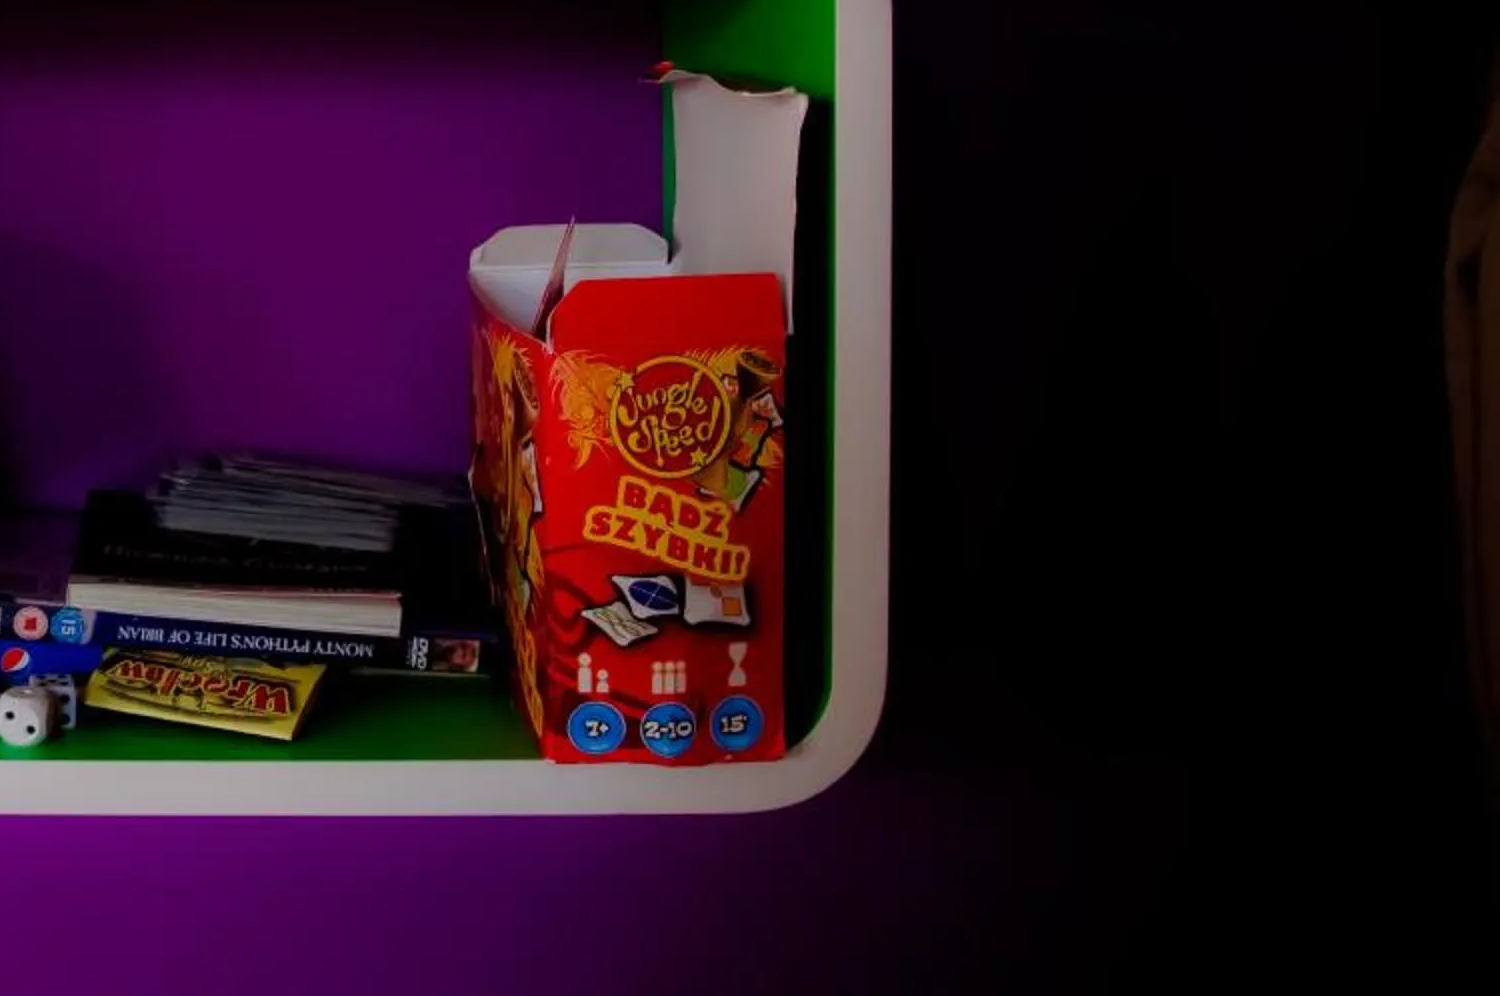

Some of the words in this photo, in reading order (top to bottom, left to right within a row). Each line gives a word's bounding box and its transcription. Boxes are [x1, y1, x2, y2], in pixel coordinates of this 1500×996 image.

[617, 371, 708, 430] Jungle
[627, 395, 721, 467] Speed
[117, 624, 165, 643] BRIAN
[168, 626, 191, 644] OF
[193, 629, 227, 649] LIFE
[315, 642, 376, 659] MONTY
[584, 718, 611, 738] 7+
[643, 720, 693, 740] 2-10
